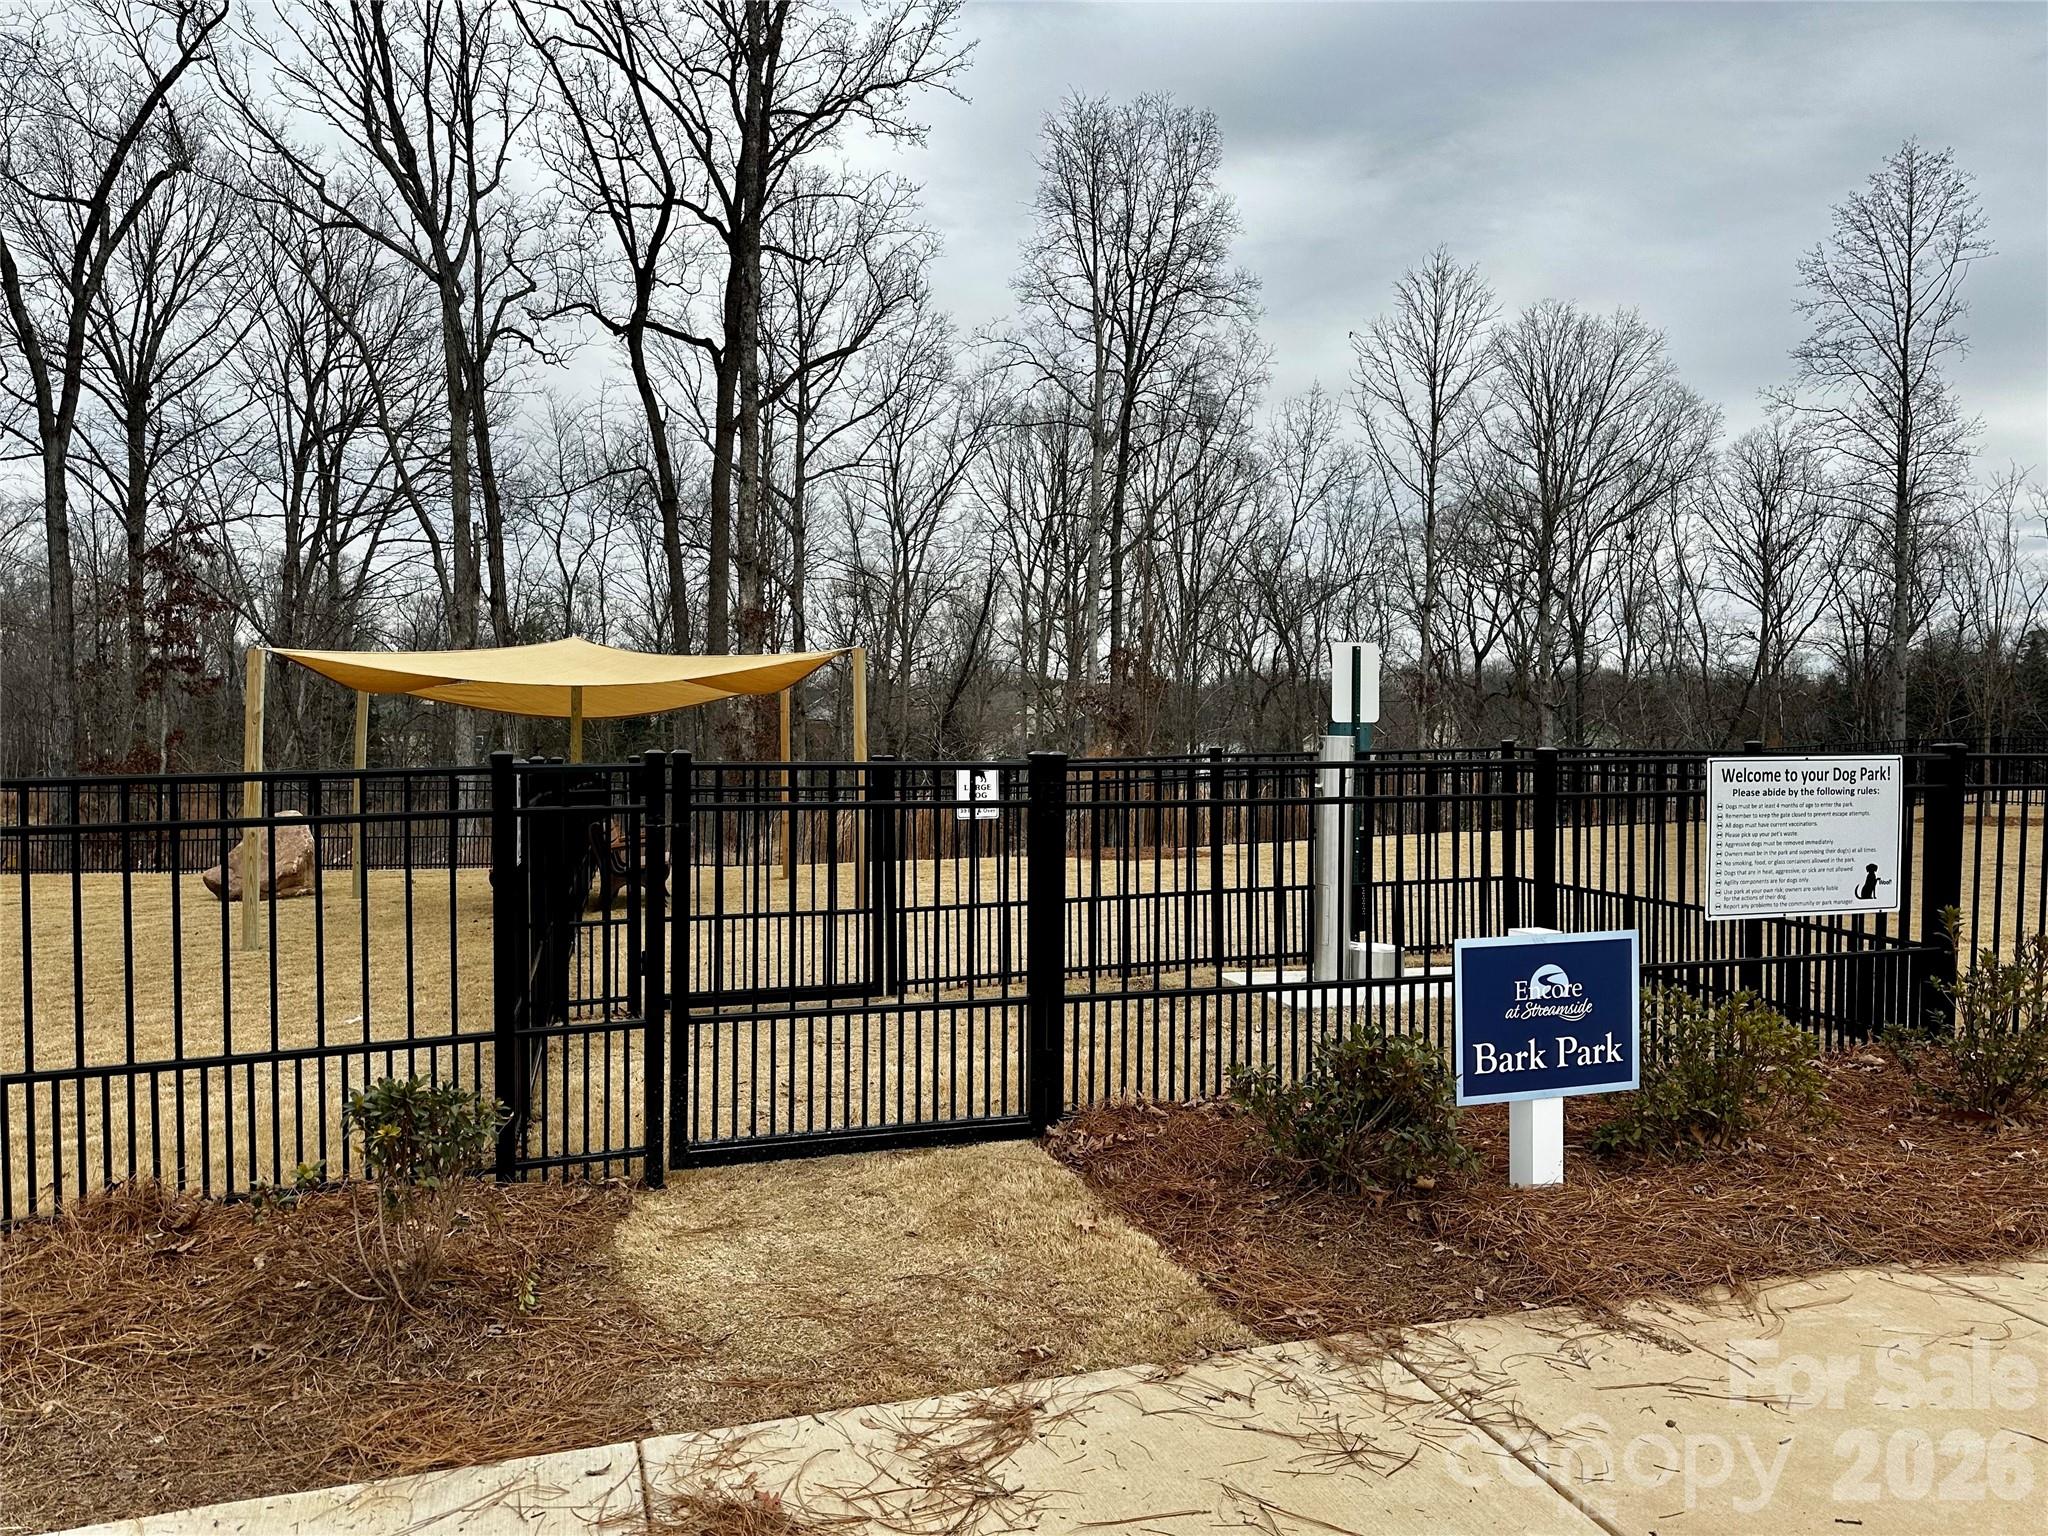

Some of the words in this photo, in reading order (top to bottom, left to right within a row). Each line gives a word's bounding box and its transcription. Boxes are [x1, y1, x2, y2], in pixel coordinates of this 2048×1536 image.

[1722, 768, 1781, 782] Welcome
[1785, 769, 1798, 782] to
[1801, 769, 1829, 784] your
[1833, 768, 1856, 784] Dog
[1860, 766, 1891, 781] Park!
[1788, 788, 1798, 797] by
[1817, 788, 1855, 796] following
[1515, 981, 1582, 1001] Encore
[1505, 1004, 1520, 1019] at
[1521, 998, 1593, 1019] Streamside
[1473, 1038, 1548, 1075] Bark
[1556, 1032, 1623, 1067] Park
